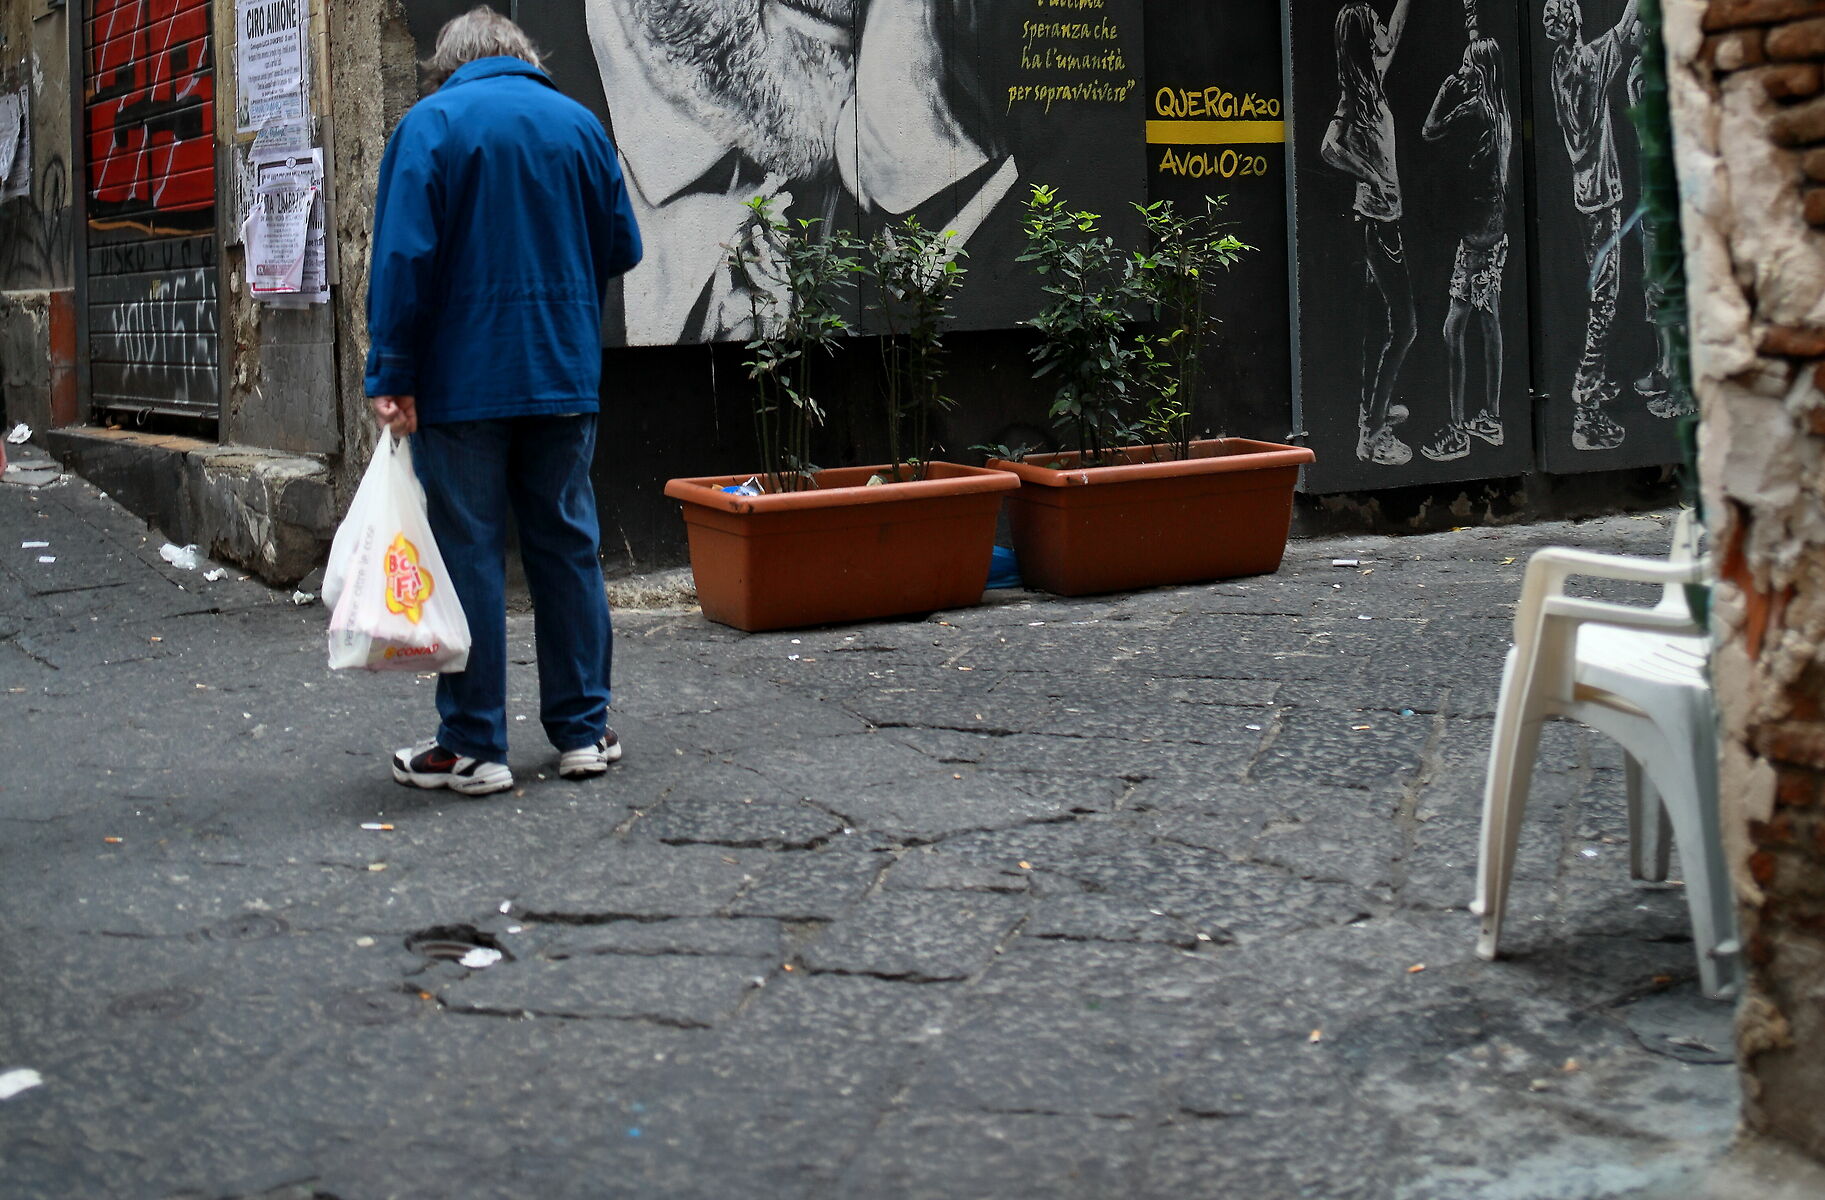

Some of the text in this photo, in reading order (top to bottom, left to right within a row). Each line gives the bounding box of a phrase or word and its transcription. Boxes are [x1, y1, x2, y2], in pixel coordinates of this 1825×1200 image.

[246, 5, 265, 40] CIRO
[1094, 16, 1119, 40] che
[1021, 45, 1126, 71] ha l'umanità
[1005, 85, 1033, 117] per
